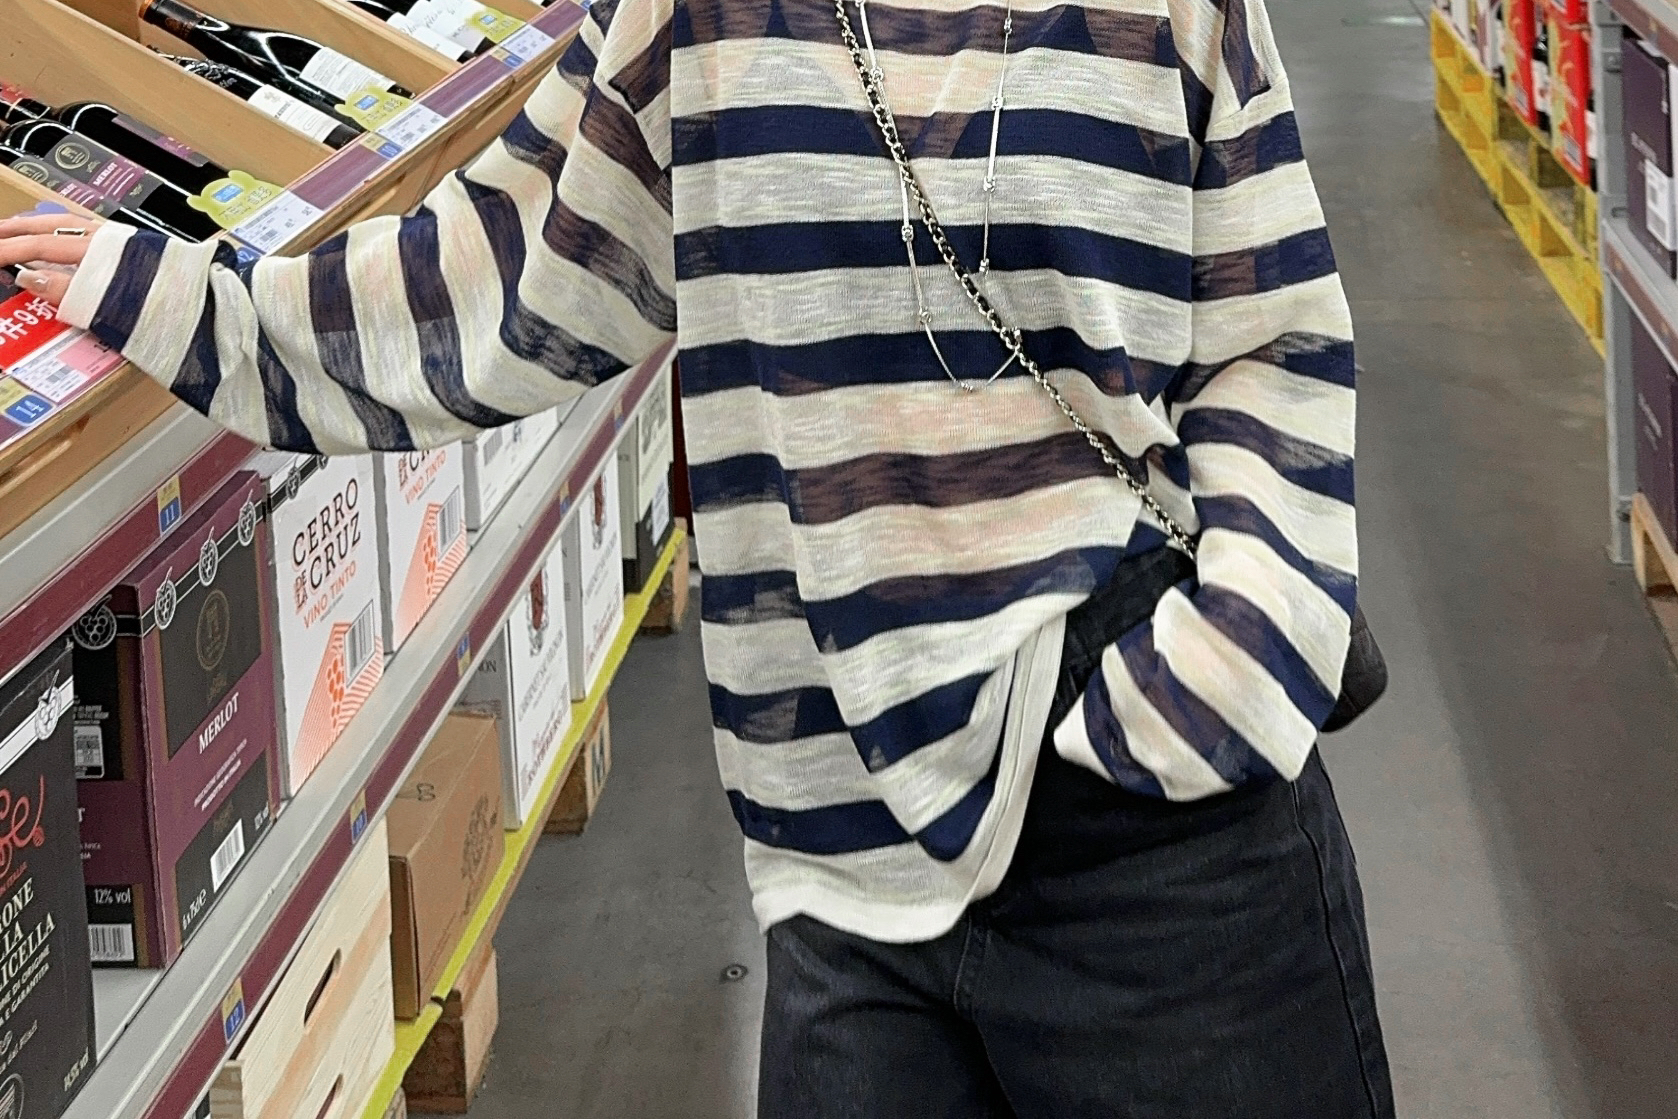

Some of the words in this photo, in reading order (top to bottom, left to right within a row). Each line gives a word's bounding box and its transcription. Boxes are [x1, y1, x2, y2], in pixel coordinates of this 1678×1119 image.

[92, 161, 119, 187] MERLOT
[0, 295, 58, 346] 件9折
[15, 398, 46, 419] 14
[292, 477, 359, 567] CERRO
[295, 569, 308, 593] DE
[309, 511, 361, 590] CRUZ
[303, 593, 329, 629] VINO
[329, 559, 357, 600] TINTO
[198, 691, 240, 755] MERLOT
[94, 888, 114, 905] 12%
[115, 887, 131, 904] vol
[11, 962, 50, 1014] GARANTITA
